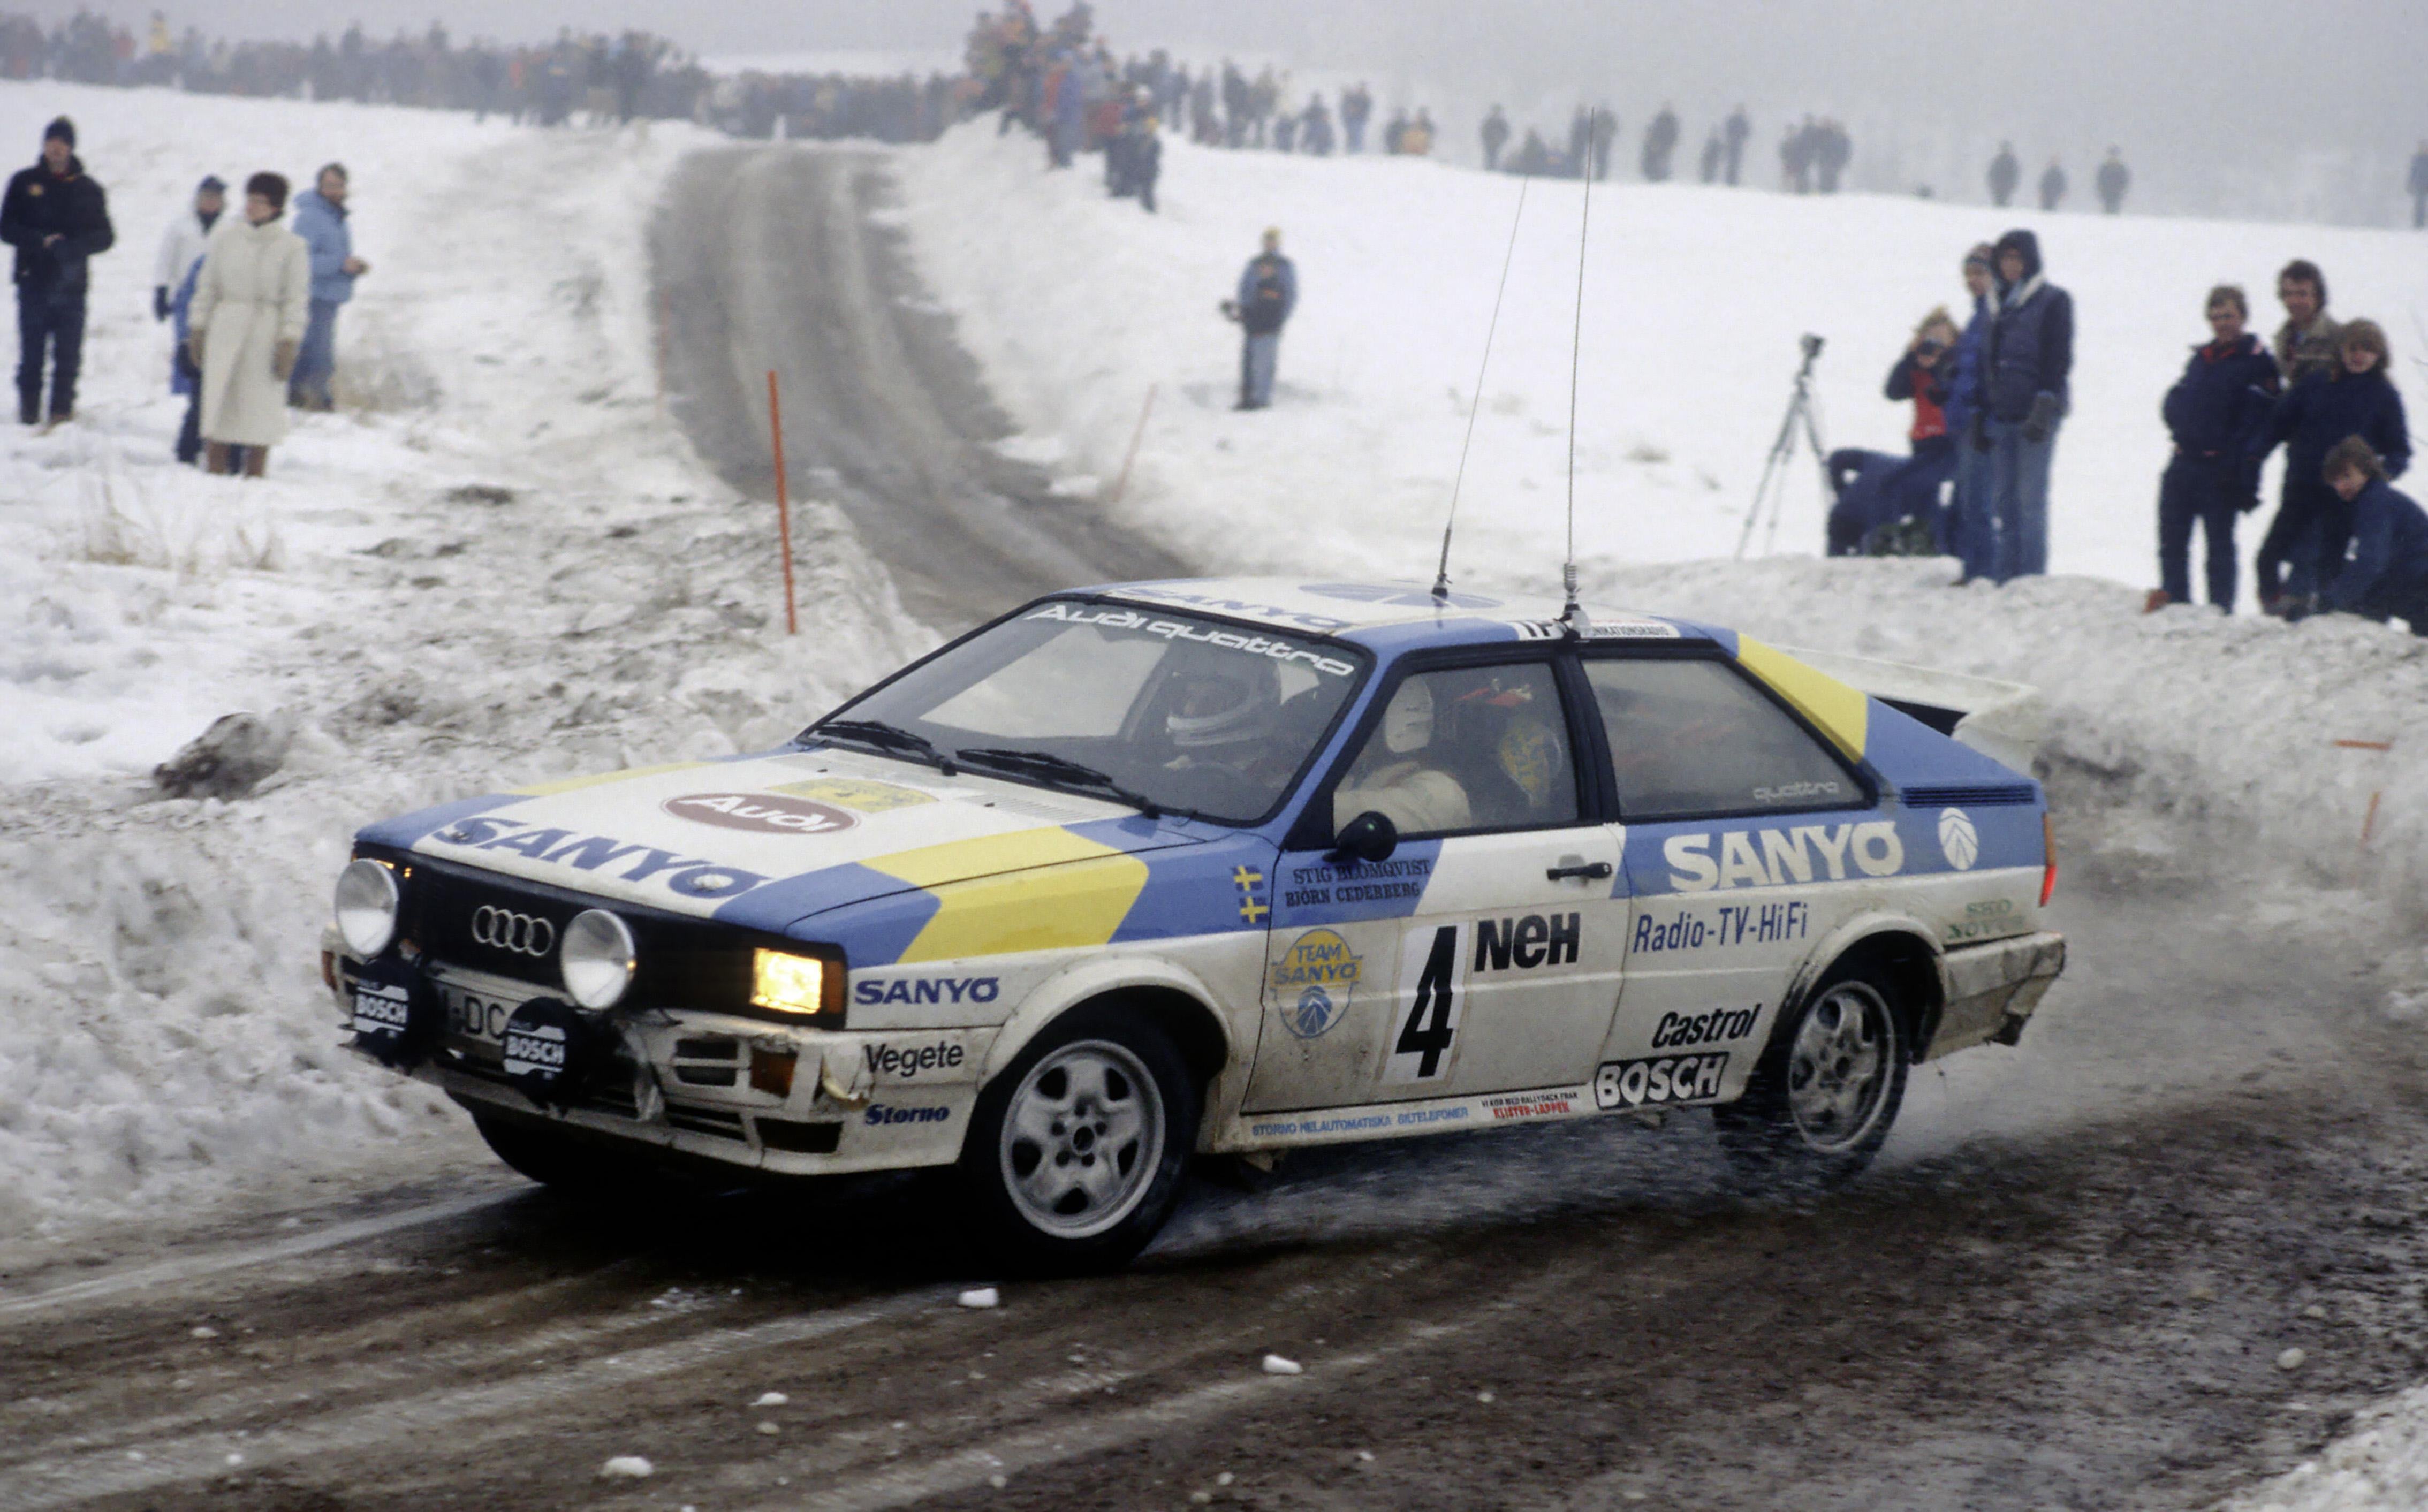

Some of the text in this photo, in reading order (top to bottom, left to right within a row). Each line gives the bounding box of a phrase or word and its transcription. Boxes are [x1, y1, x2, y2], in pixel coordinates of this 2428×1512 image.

[1023, 605, 1354, 676] Audi quattro
[1753, 781, 1839, 803] quattro
[673, 792, 841, 831] Audi
[433, 817, 775, 899] SANYO
[1293, 859, 1431, 884] STIG BLOMQVIST
[1663, 821, 1905, 892] SANYO
[1286, 882, 1421, 908] BJÖRN CEDERBERG
[1633, 902, 1809, 954] Radio-TV-HiFi
[1296, 943, 1342, 963] TEAM
[1274, 963, 1357, 985] SANYO
[855, 976, 1000, 1006] SANYO
[1395, 925, 1457, 1078] 4
[355, 993, 409, 1025] BOSCH
[1652, 1002, 1762, 1049] Castrol
[506, 1035, 566, 1066] BOSCH
[864, 1040, 963, 1077] Vegete
[1596, 1054, 1726, 1107] BOSCH
[864, 1104, 950, 1126] Storno
[1253, 1122, 1296, 1136] STORNO
